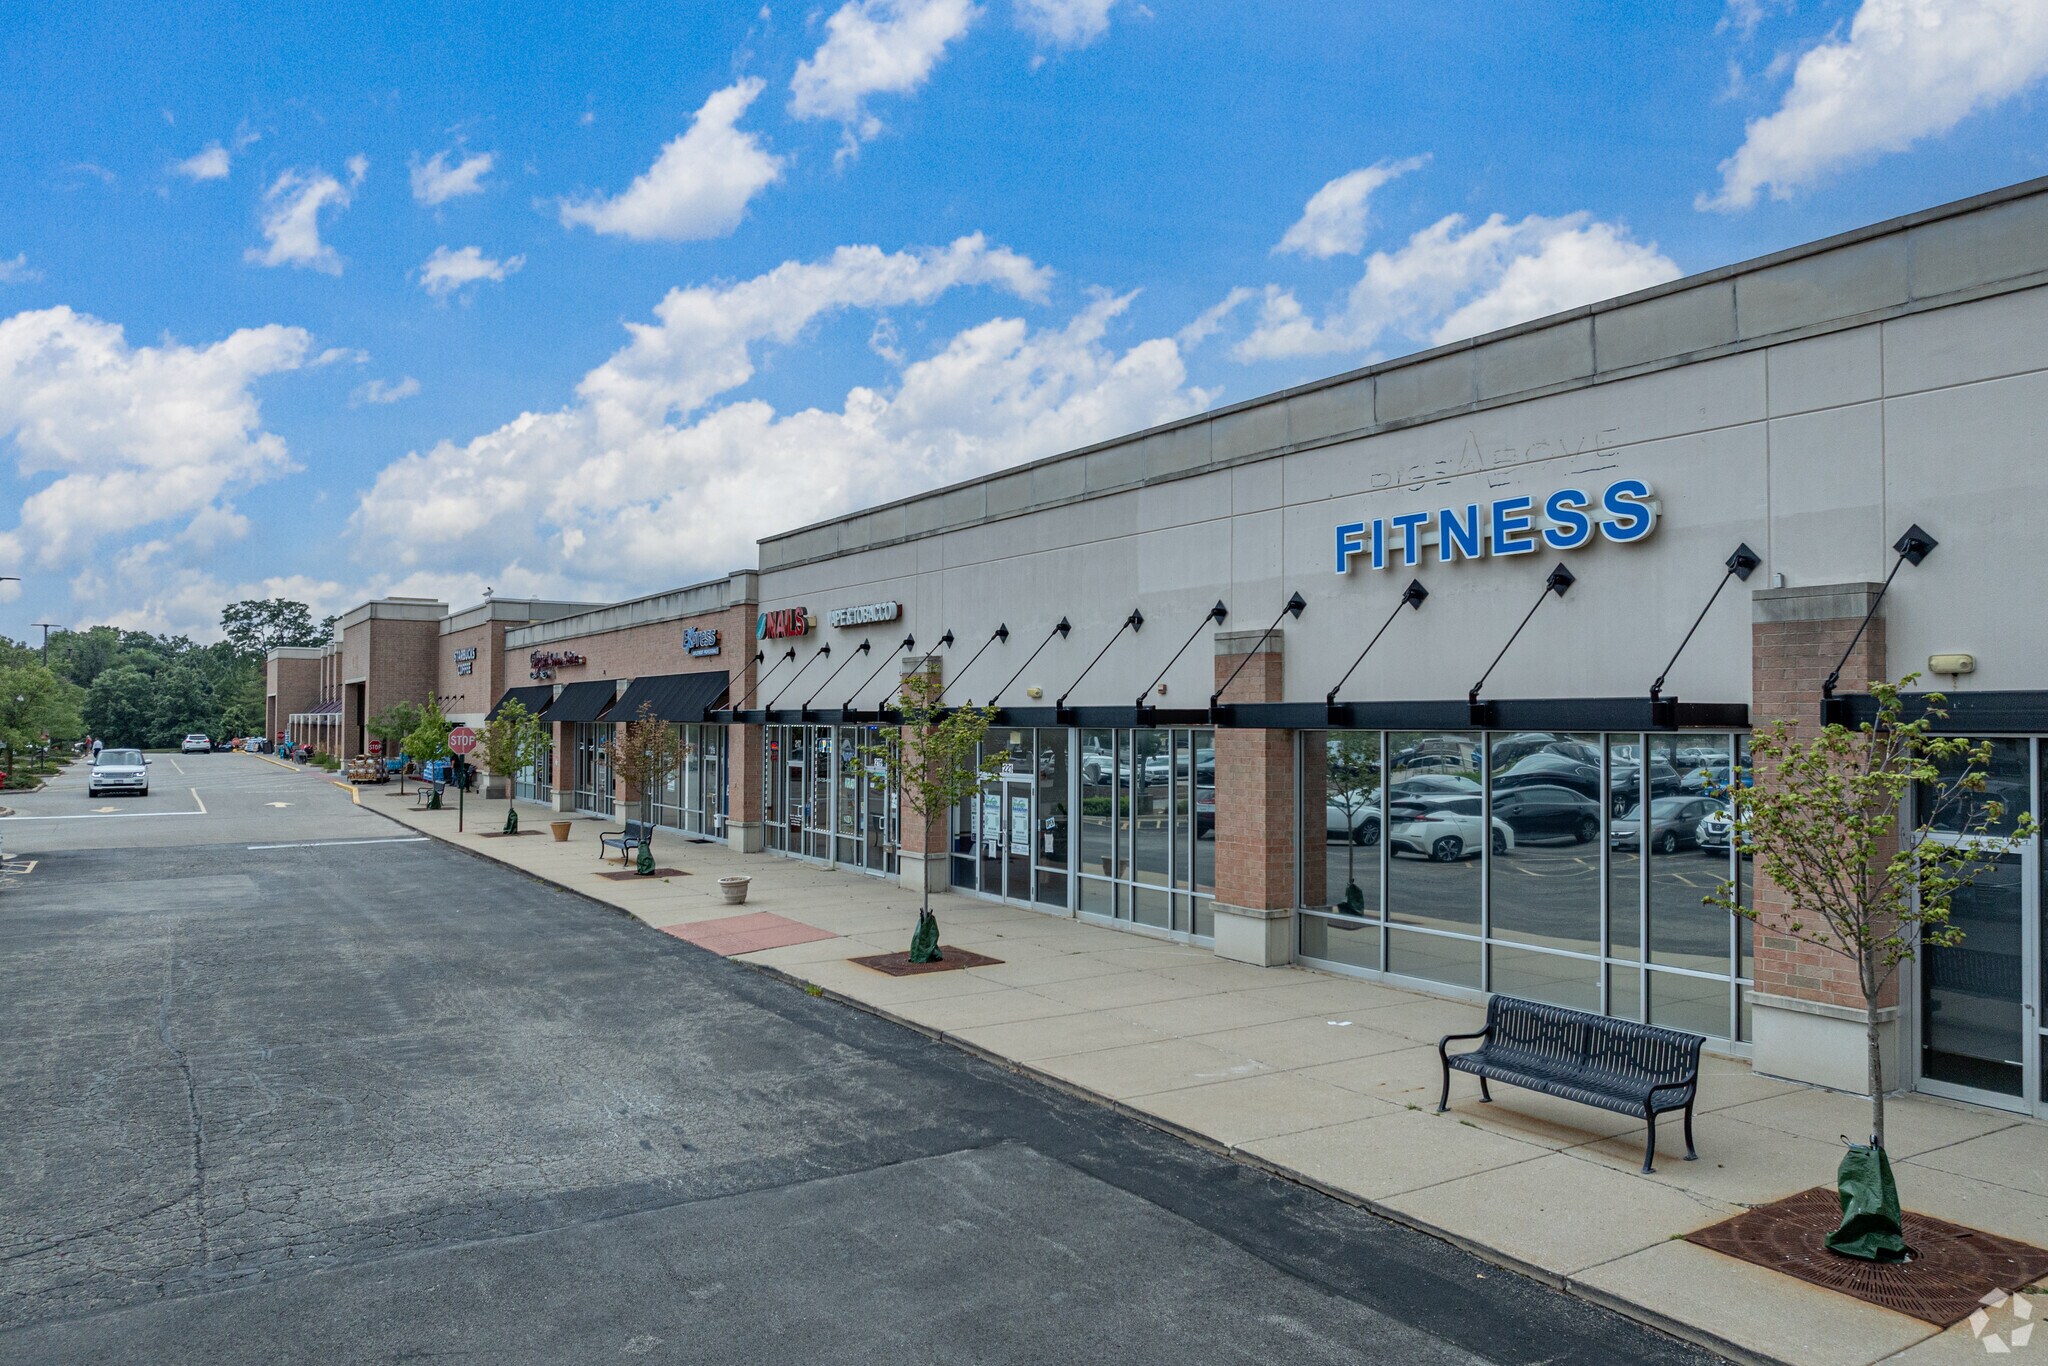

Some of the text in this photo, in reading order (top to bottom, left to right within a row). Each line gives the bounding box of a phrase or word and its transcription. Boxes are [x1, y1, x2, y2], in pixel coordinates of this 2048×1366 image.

[1334, 478, 1659, 575] FITNESS
[766, 607, 808, 639] NAILS
[450, 735, 475, 746] STOP
